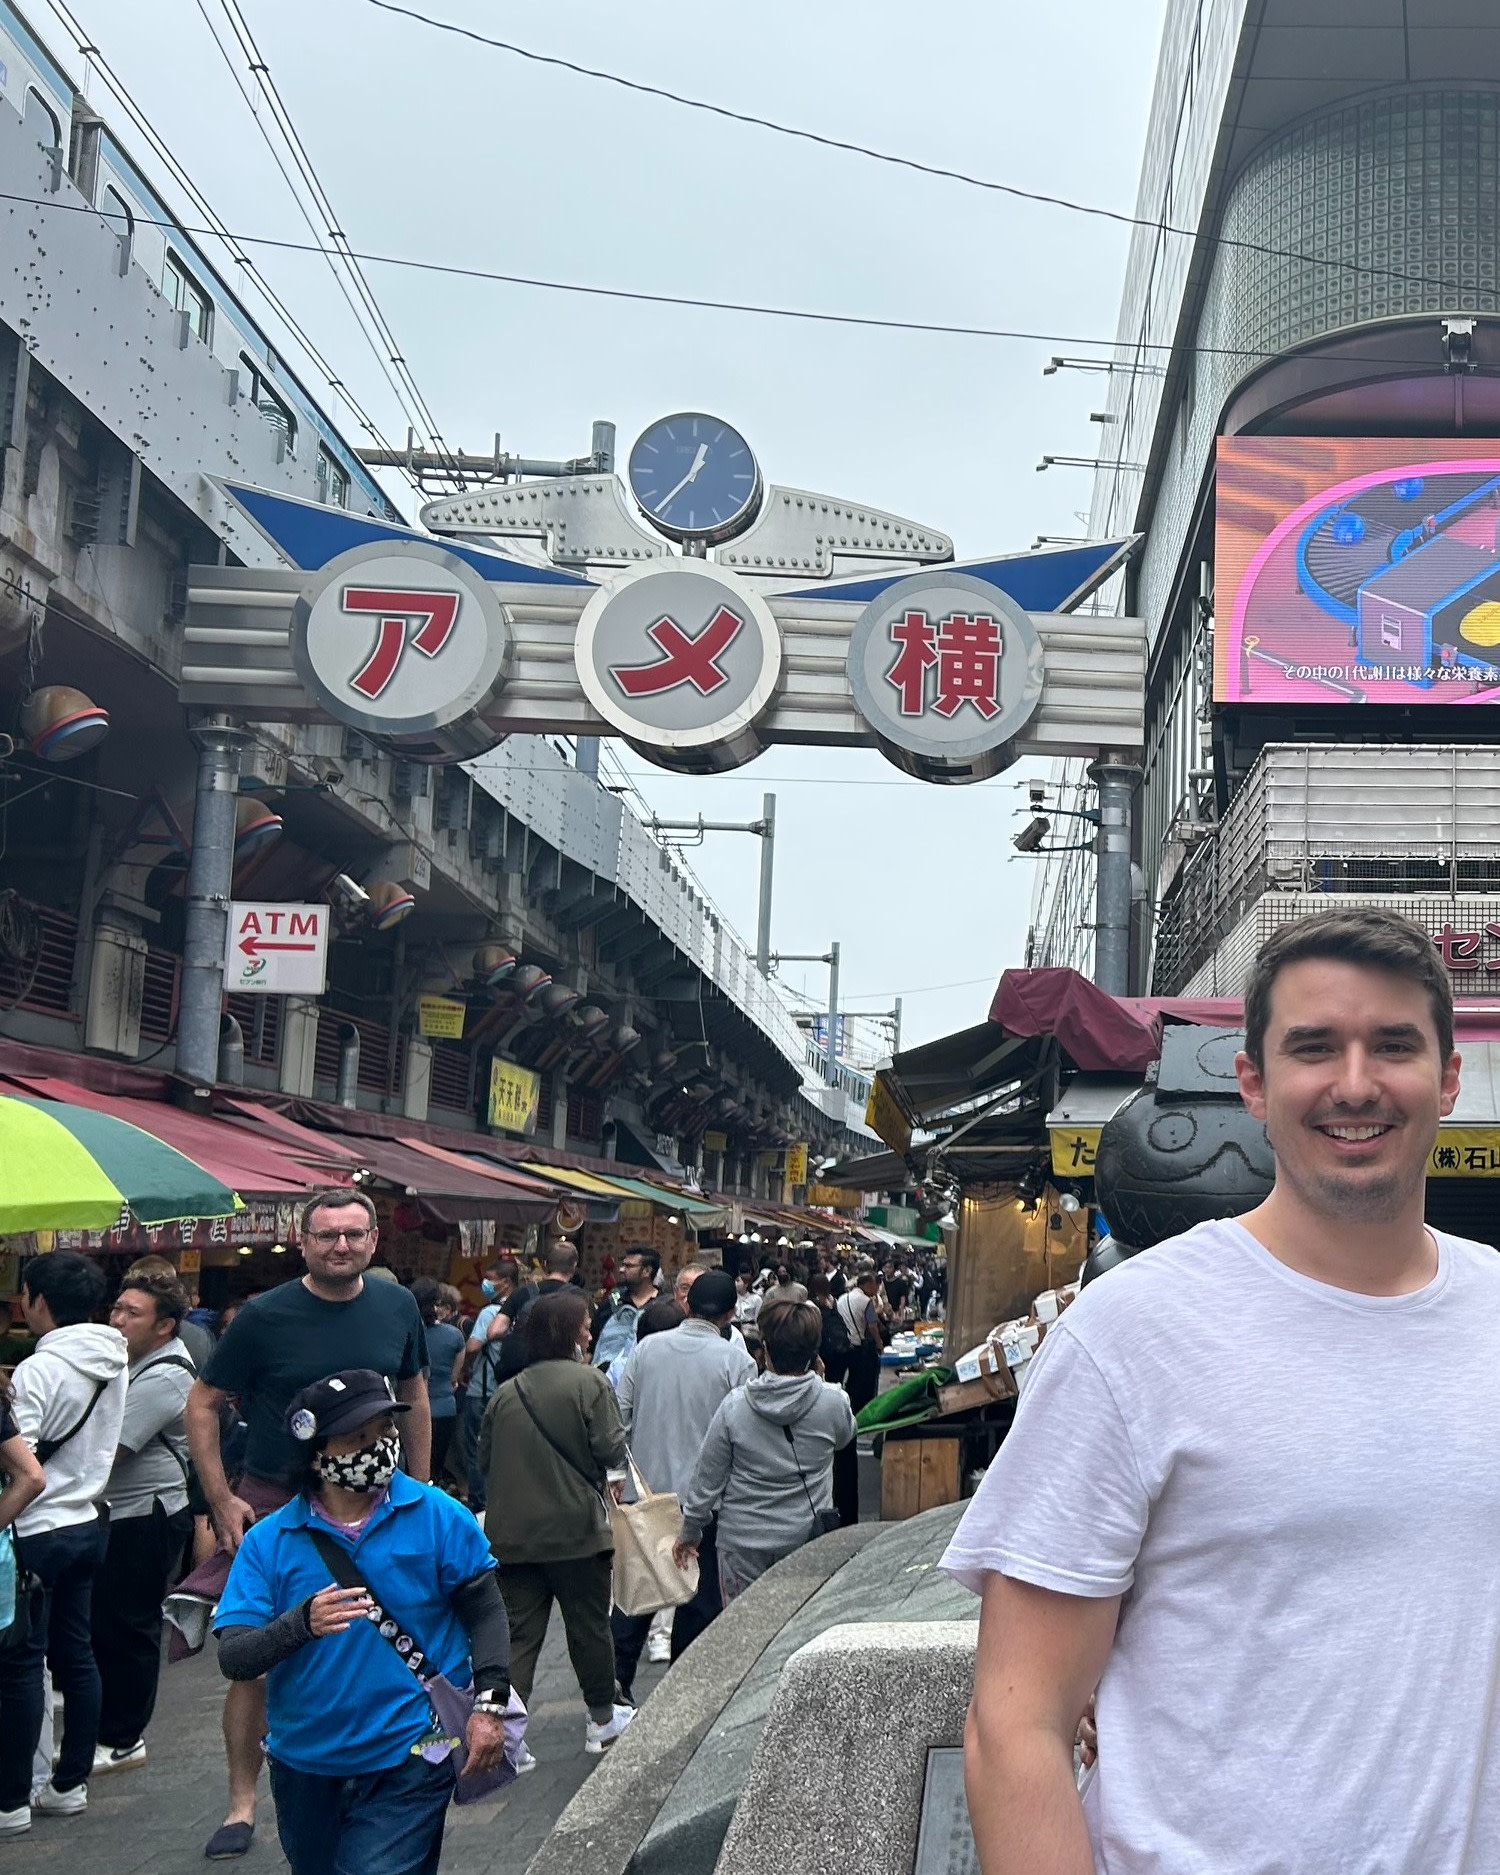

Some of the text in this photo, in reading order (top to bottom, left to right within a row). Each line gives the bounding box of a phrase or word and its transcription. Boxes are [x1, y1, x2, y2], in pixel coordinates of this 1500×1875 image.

[342, 585, 1003, 720] アメ横
[239, 912, 318, 936] ATM
